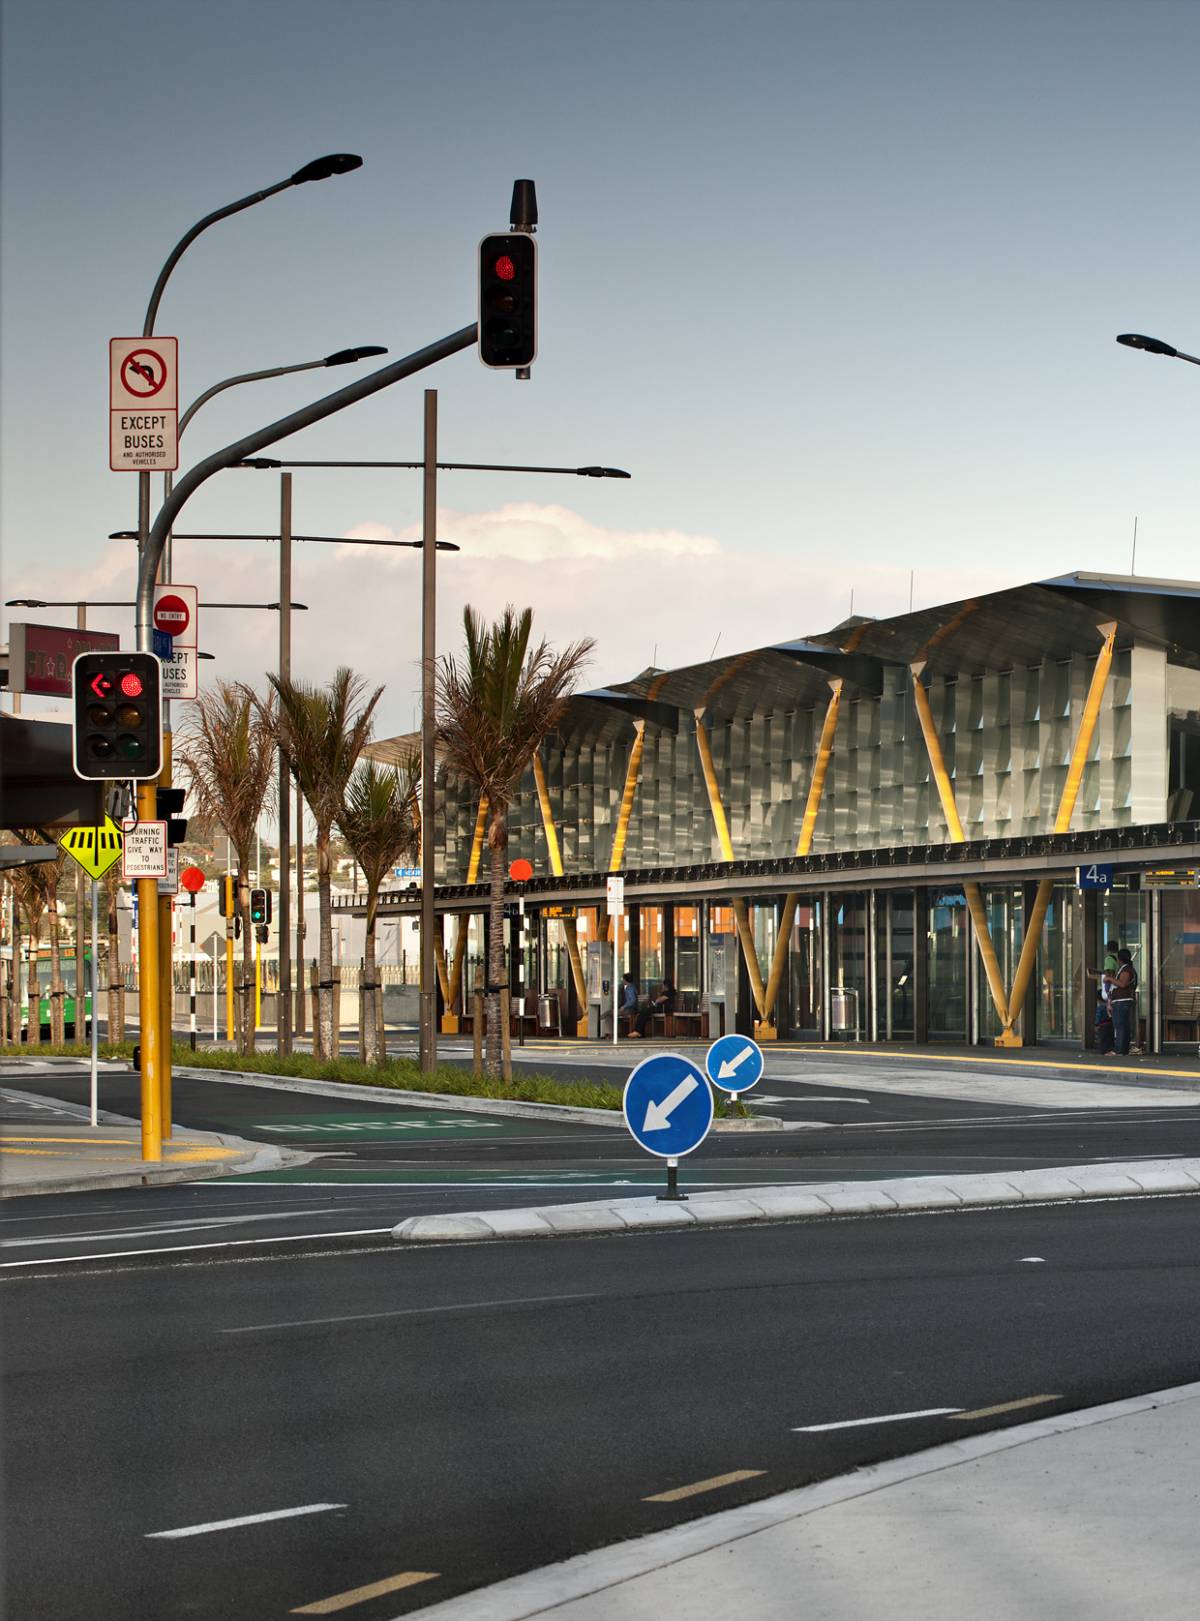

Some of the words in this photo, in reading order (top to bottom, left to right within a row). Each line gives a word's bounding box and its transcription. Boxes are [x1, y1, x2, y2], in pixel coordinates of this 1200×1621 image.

[121, 416, 166, 430] EXCEPT
[125, 435, 164, 448] BUSES
[162, 668, 187, 680] USES
[131, 837, 159, 845] TRAFFIC
[127, 846, 142, 854] GIVE
[149, 846, 163, 854] WAY
[142, 855, 150, 863] TO
[1086, 865, 1108, 883] 4a
